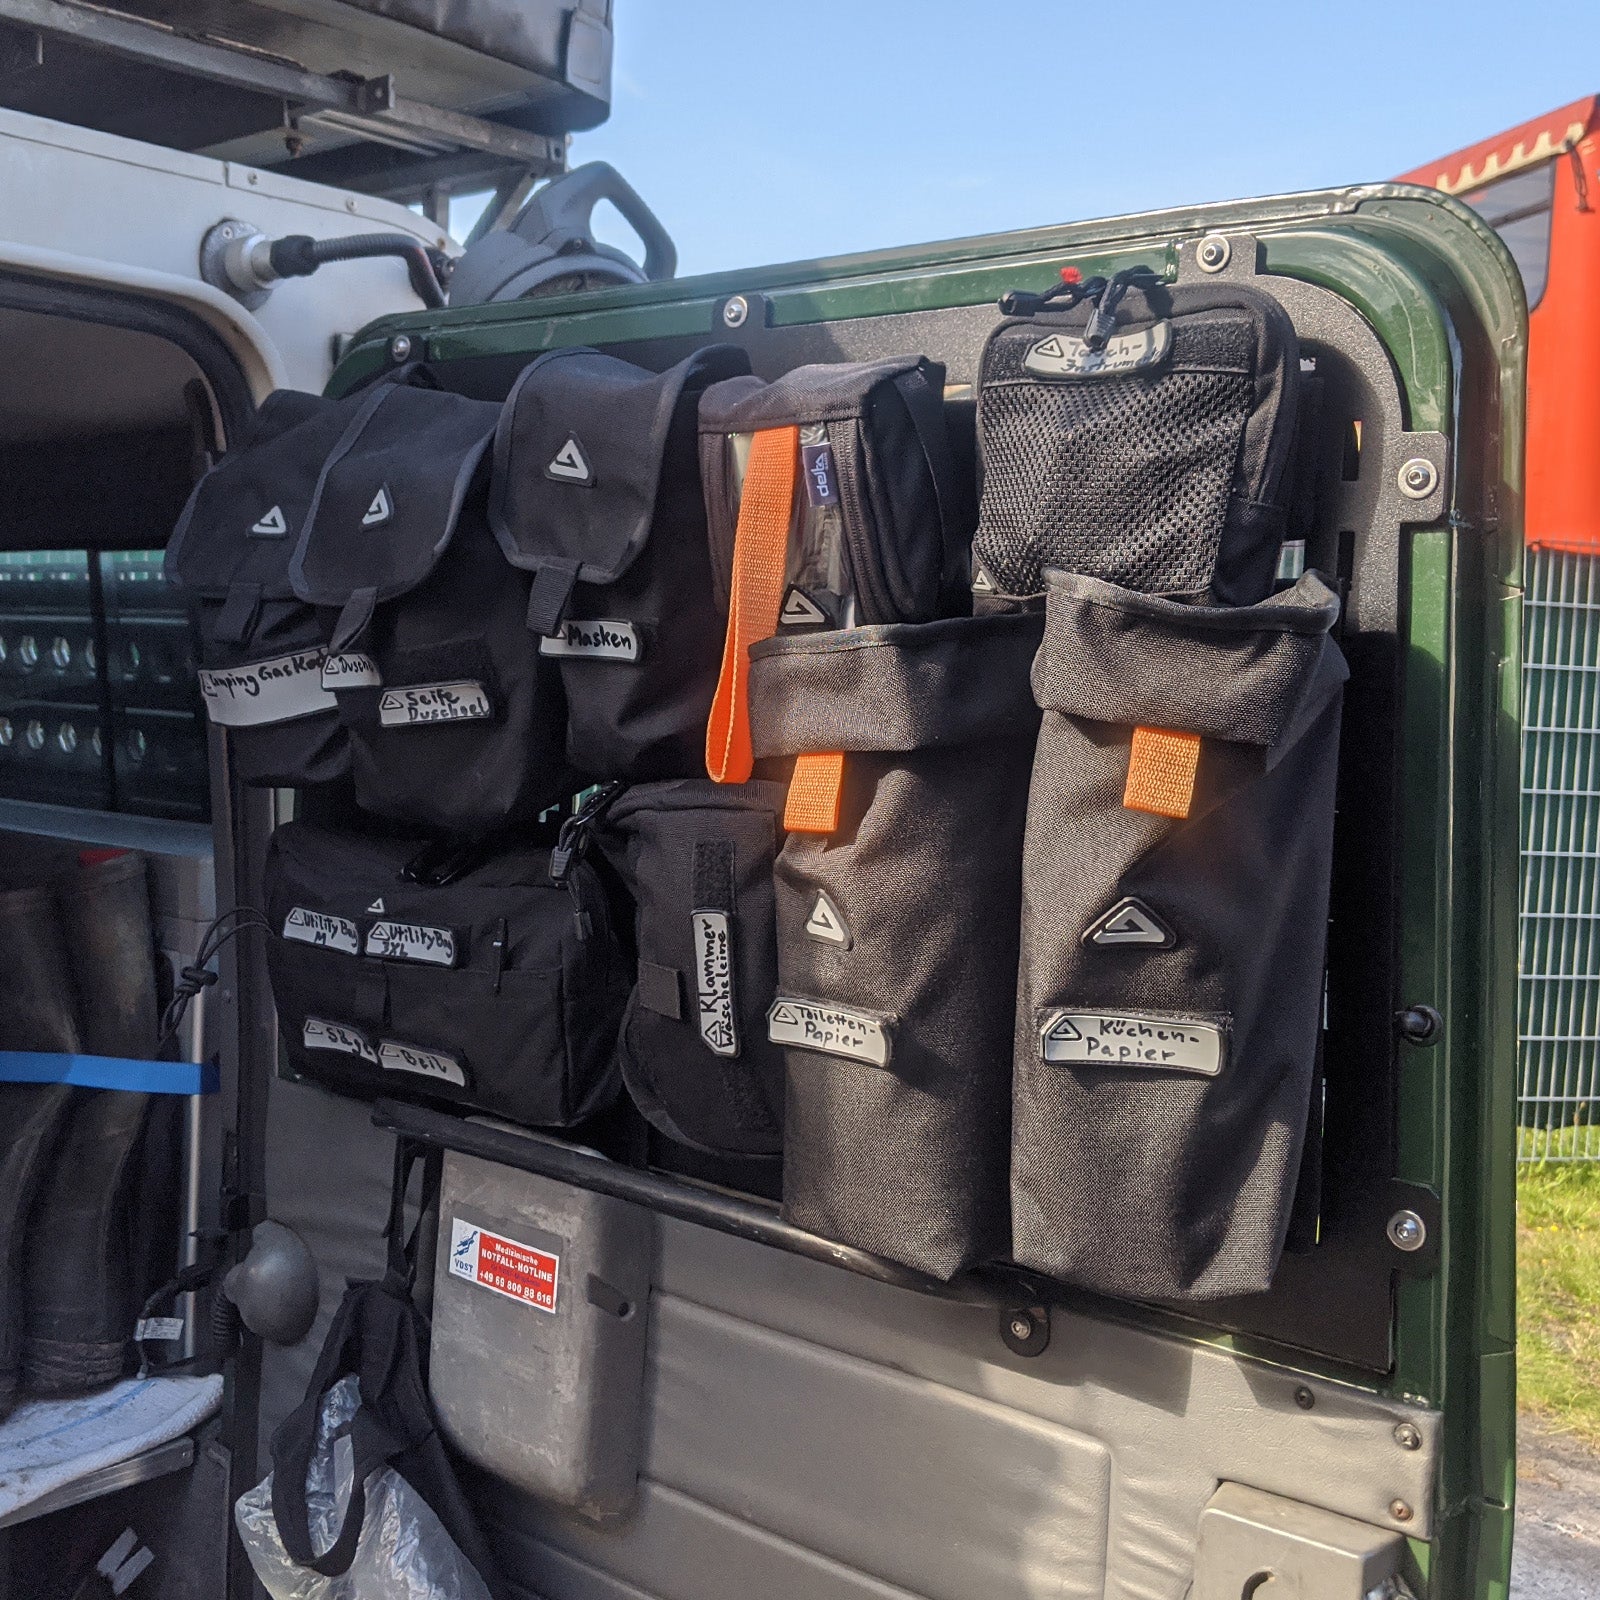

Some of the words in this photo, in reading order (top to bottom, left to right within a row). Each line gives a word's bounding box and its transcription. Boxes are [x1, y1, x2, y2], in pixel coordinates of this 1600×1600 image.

[810, 453, 829, 497] delta
[567, 624, 631, 650] Masken
[258, 661, 293, 681] Gas
[405, 688, 460, 706] Seife
[314, 931, 327, 945] M
[389, 925, 435, 950] Utility
[699, 919, 718, 1013] Klammer
[715, 930, 735, 1047] Wäscheleine
[794, 1005, 876, 1035] Toiletten-
[1099, 1018, 1200, 1043] Küchen-
[804, 1021, 864, 1047] Papier
[401, 1049, 447, 1073] Beil
[1086, 1036, 1176, 1062] Papier
[454, 1258, 474, 1273] VDST
[481, 1248, 553, 1283] NOTFALL-HOTLINE
[495, 1243, 539, 1266] Medizinische
[479, 1271, 494, 1282] +49
[495, 1276, 505, 1288] 69
[507, 1280, 522, 1294] 800
[536, 1291, 552, 1305] 616
